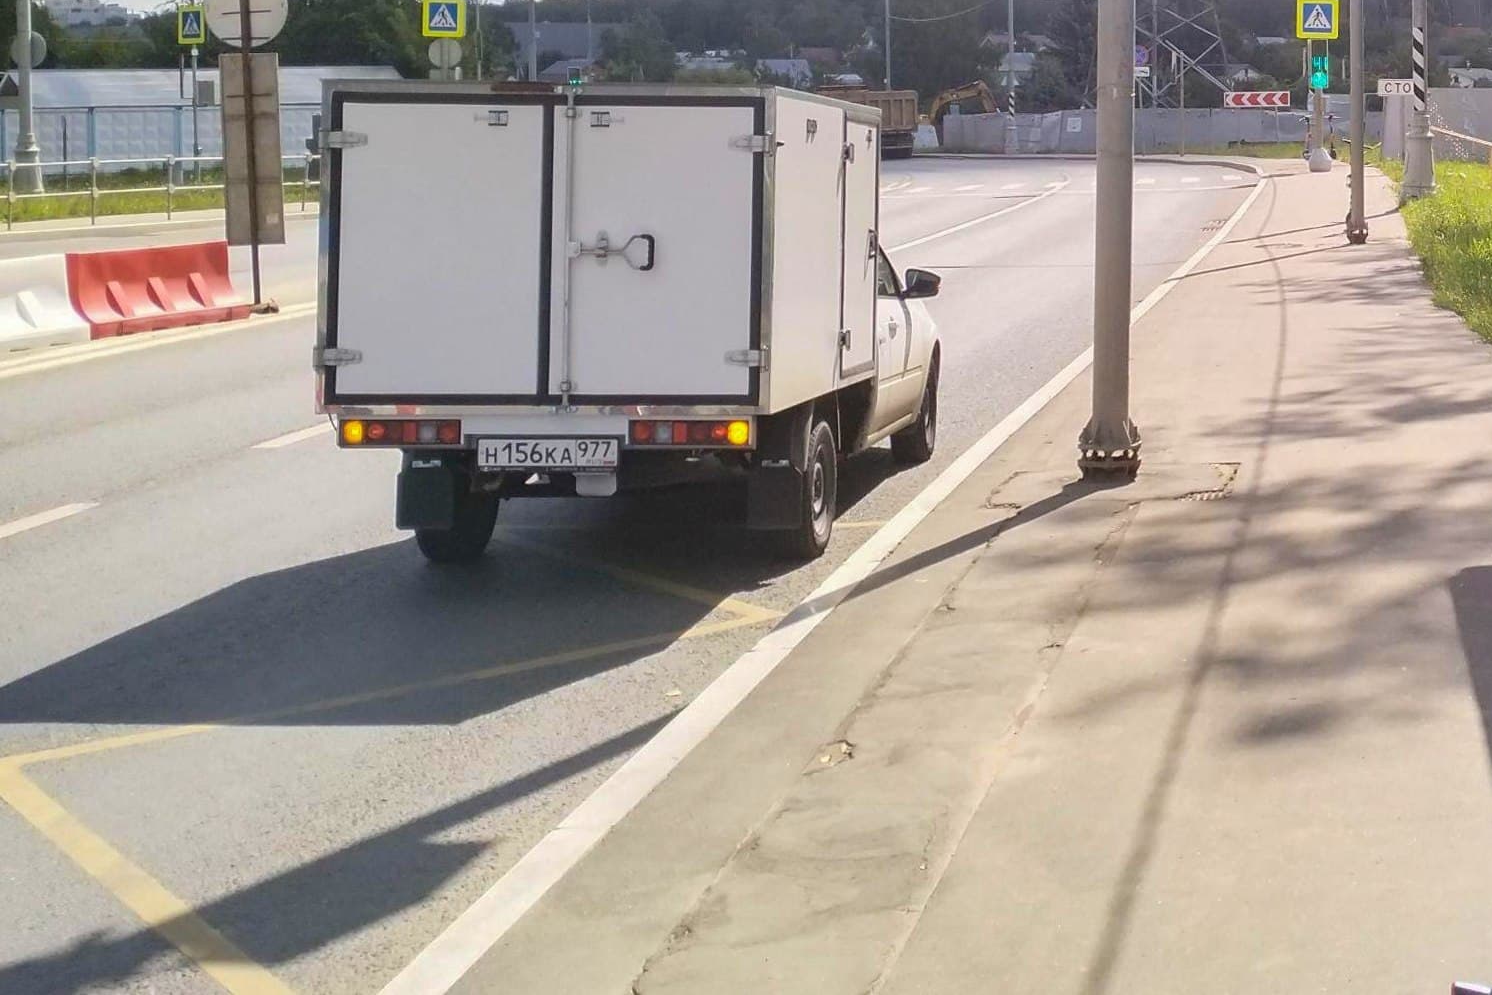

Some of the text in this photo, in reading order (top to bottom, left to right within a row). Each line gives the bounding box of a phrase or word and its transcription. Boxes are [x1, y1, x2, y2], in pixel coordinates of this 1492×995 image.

[1384, 82, 1412, 93] СТО
[485, 441, 612, 464] Н156КА 977
